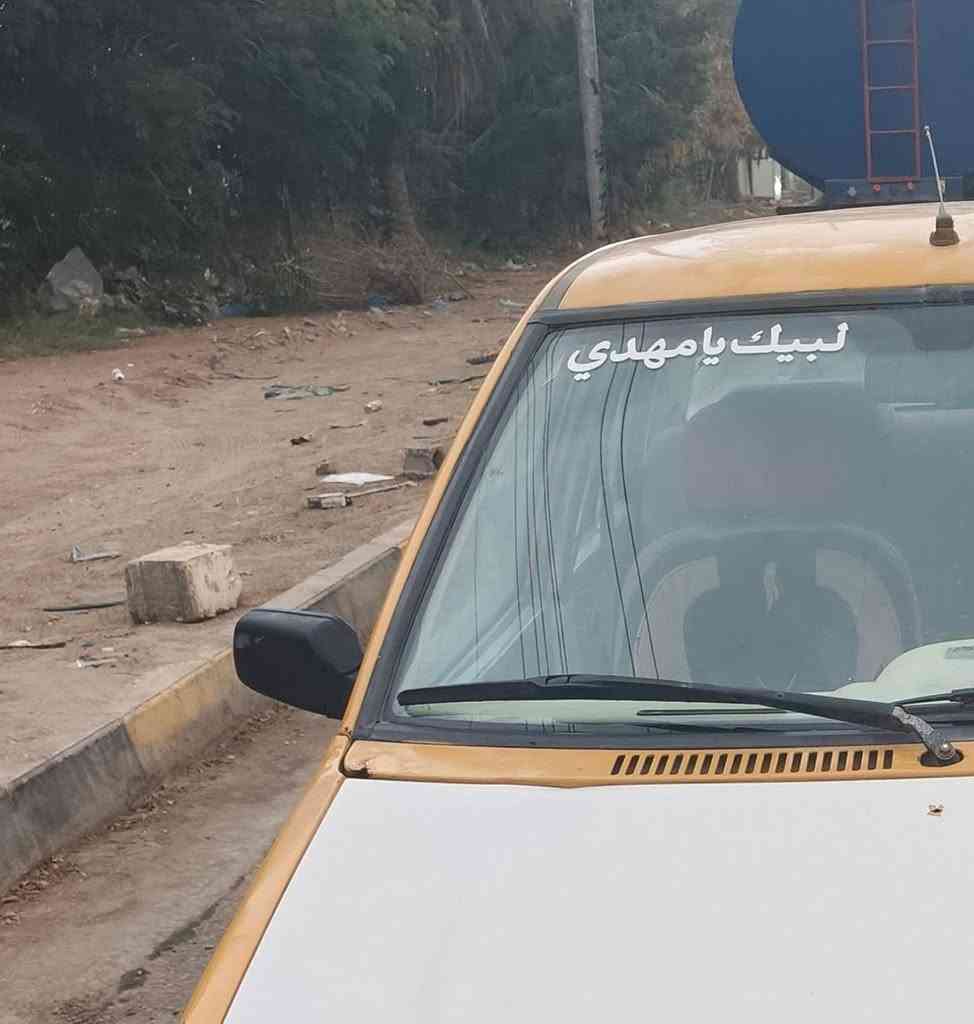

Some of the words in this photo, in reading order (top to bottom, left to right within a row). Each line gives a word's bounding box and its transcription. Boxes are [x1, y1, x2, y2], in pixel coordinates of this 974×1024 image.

[567, 337, 698, 381] مهدي
[702, 326, 726, 366] يا
[731, 322, 849, 362] لبيك
